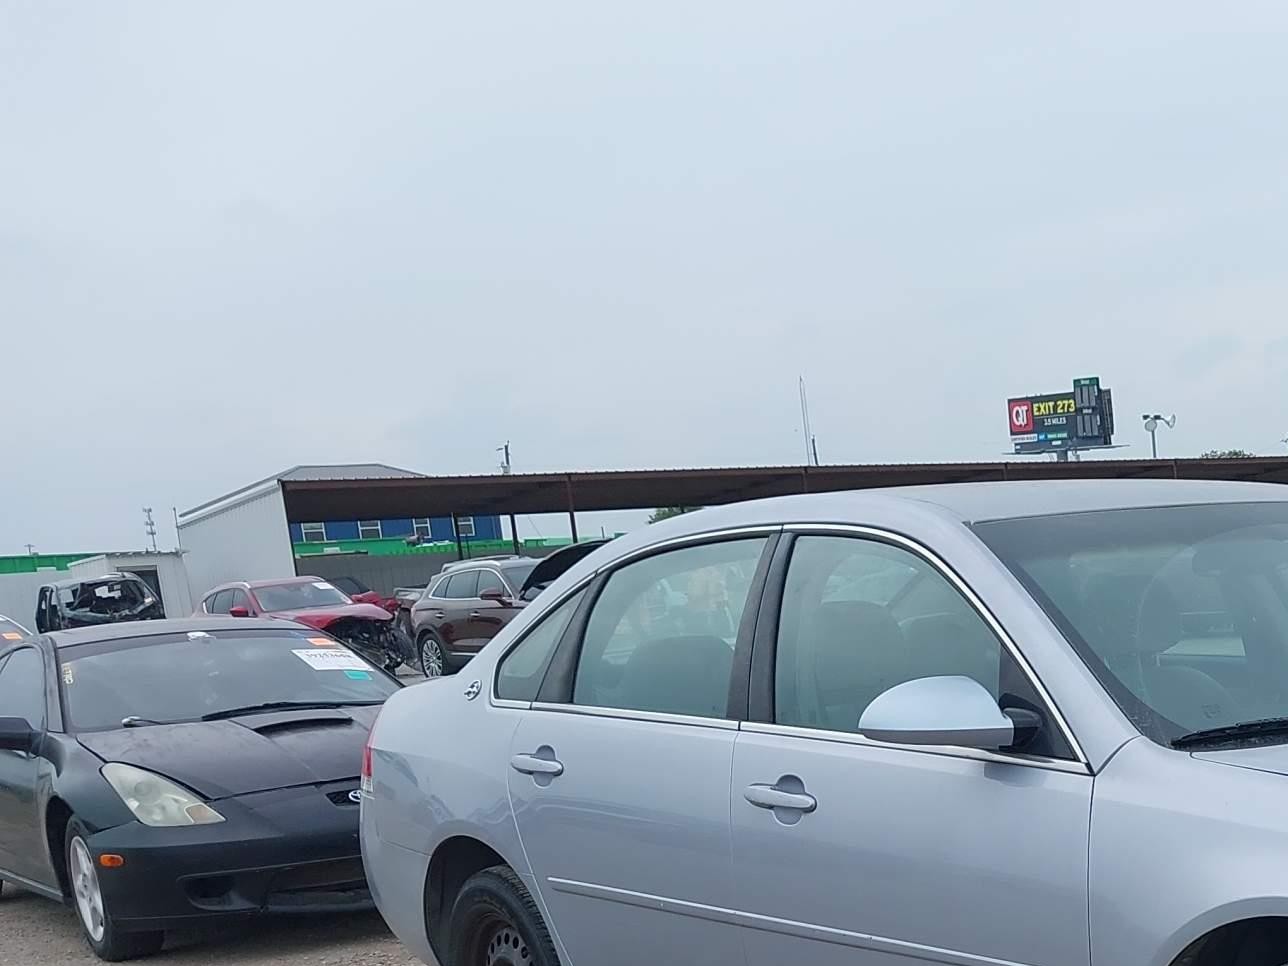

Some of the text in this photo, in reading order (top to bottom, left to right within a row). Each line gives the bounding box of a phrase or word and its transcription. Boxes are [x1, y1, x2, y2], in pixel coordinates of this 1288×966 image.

[1012, 405, 1028, 428] QT
[1033, 399, 1076, 416] EXIT 273
